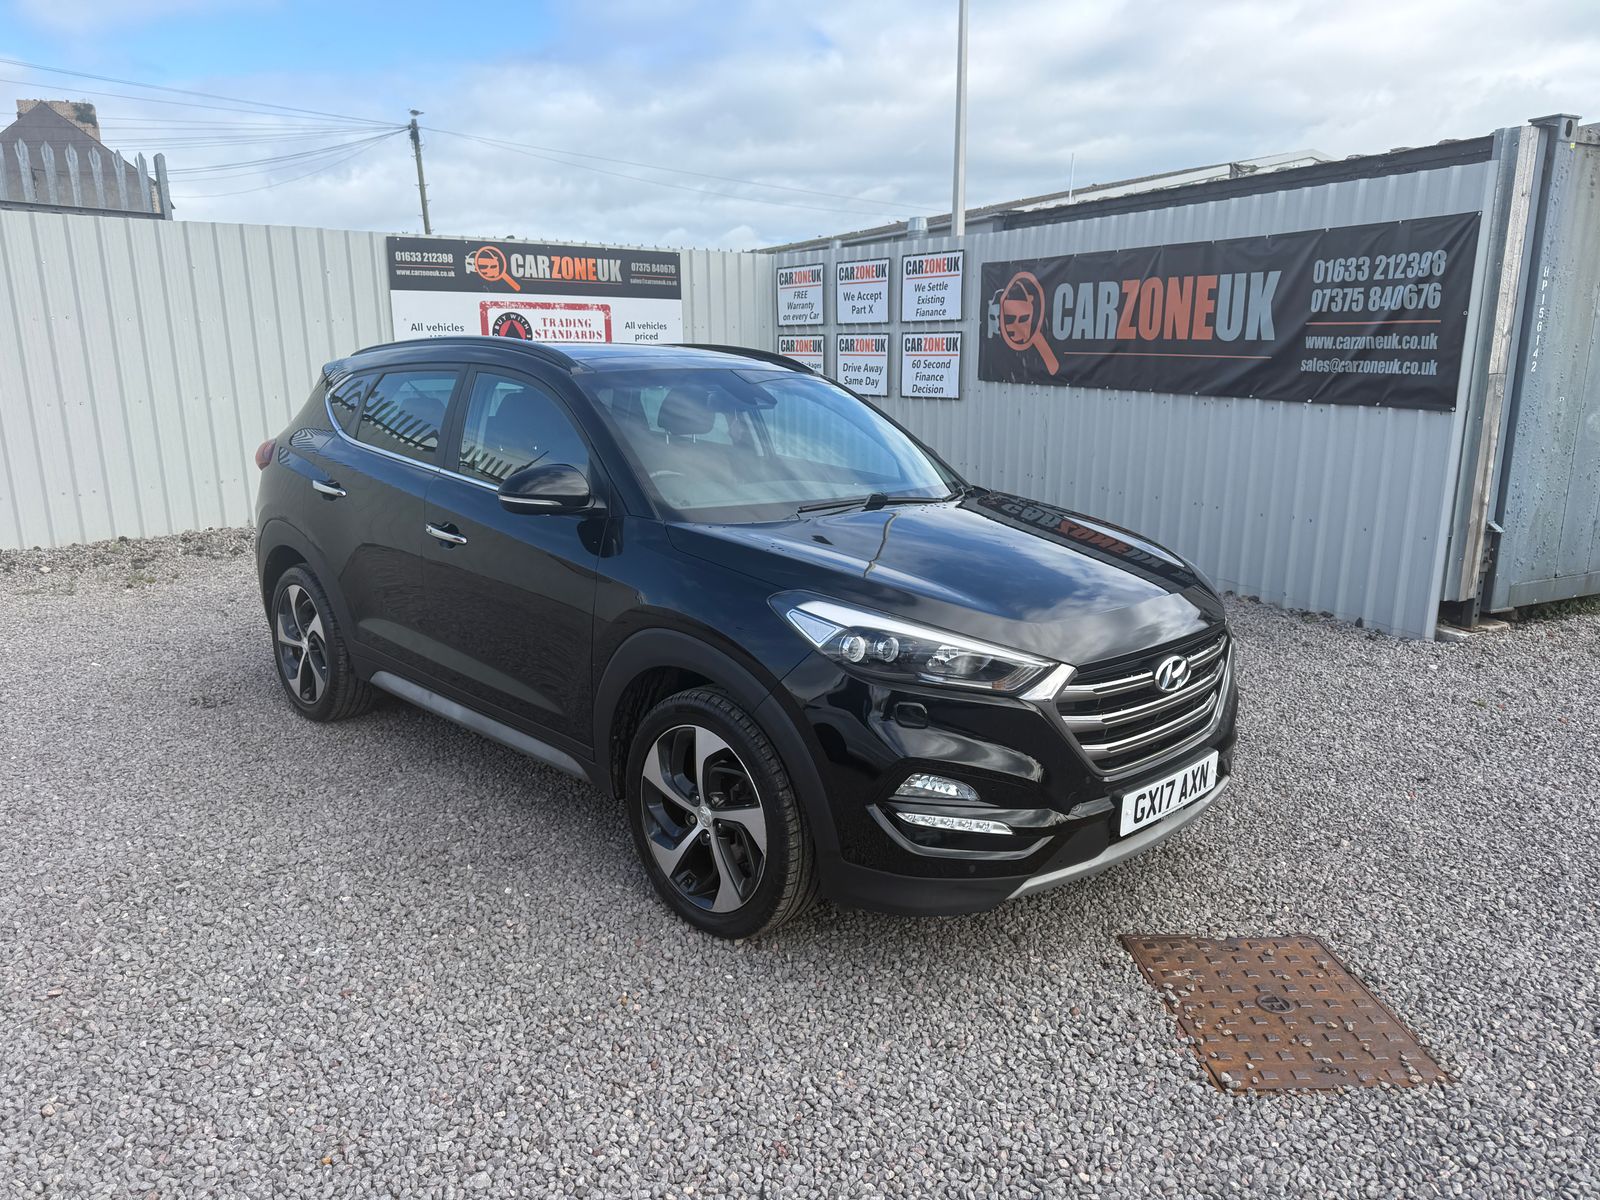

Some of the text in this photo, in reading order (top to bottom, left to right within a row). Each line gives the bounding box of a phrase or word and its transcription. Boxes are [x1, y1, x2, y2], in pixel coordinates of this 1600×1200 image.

[395, 251, 454, 263] 01633 212398
[510, 254, 622, 282] CARZONEUK
[631, 262, 650, 272] 07375
[905, 256, 960, 276] CARZONEUK
[1313, 250, 1448, 284] 01633 212398
[779, 269, 822, 286] CARZONEUK
[839, 264, 887, 281] CARZONEUK
[914, 282, 948, 292] We Settle
[793, 290, 808, 300] FREE
[843, 291, 882, 302] We Accept
[917, 294, 945, 306] Existing
[1310, 282, 1442, 312] 07375 840676
[787, 302, 814, 313] Warranty
[852, 304, 874, 315] Part X
[915, 307, 946, 317] Fianance
[1052, 270, 1282, 342] CARZONEUK
[494, 314, 530, 330] BUY WITH
[541, 317, 592, 328] TRADING
[792, 313, 808, 322] every
[809, 311, 820, 320] Car
[410, 322, 464, 332] All vehicles
[624, 321, 668, 330] All vehicles
[534, 328, 603, 340] STANDARDS
[634, 332, 659, 342] priced
[780, 340, 822, 352] CARZONEUK
[839, 338, 886, 352] CARZONEUK
[904, 337, 958, 352] CARZONEUK
[1306, 333, 1438, 350] www.carzoneuk.co.uk
[842, 363, 884, 375] Drive Away
[912, 359, 951, 368] 60 Second
[1300, 357, 1438, 376] sales@carzoneuk.co.uk
[844, 376, 880, 388] Same Day
[915, 372, 944, 382] Finance
[912, 384, 944, 394] Decision
[1134, 761, 1210, 824] GX17 AXN
